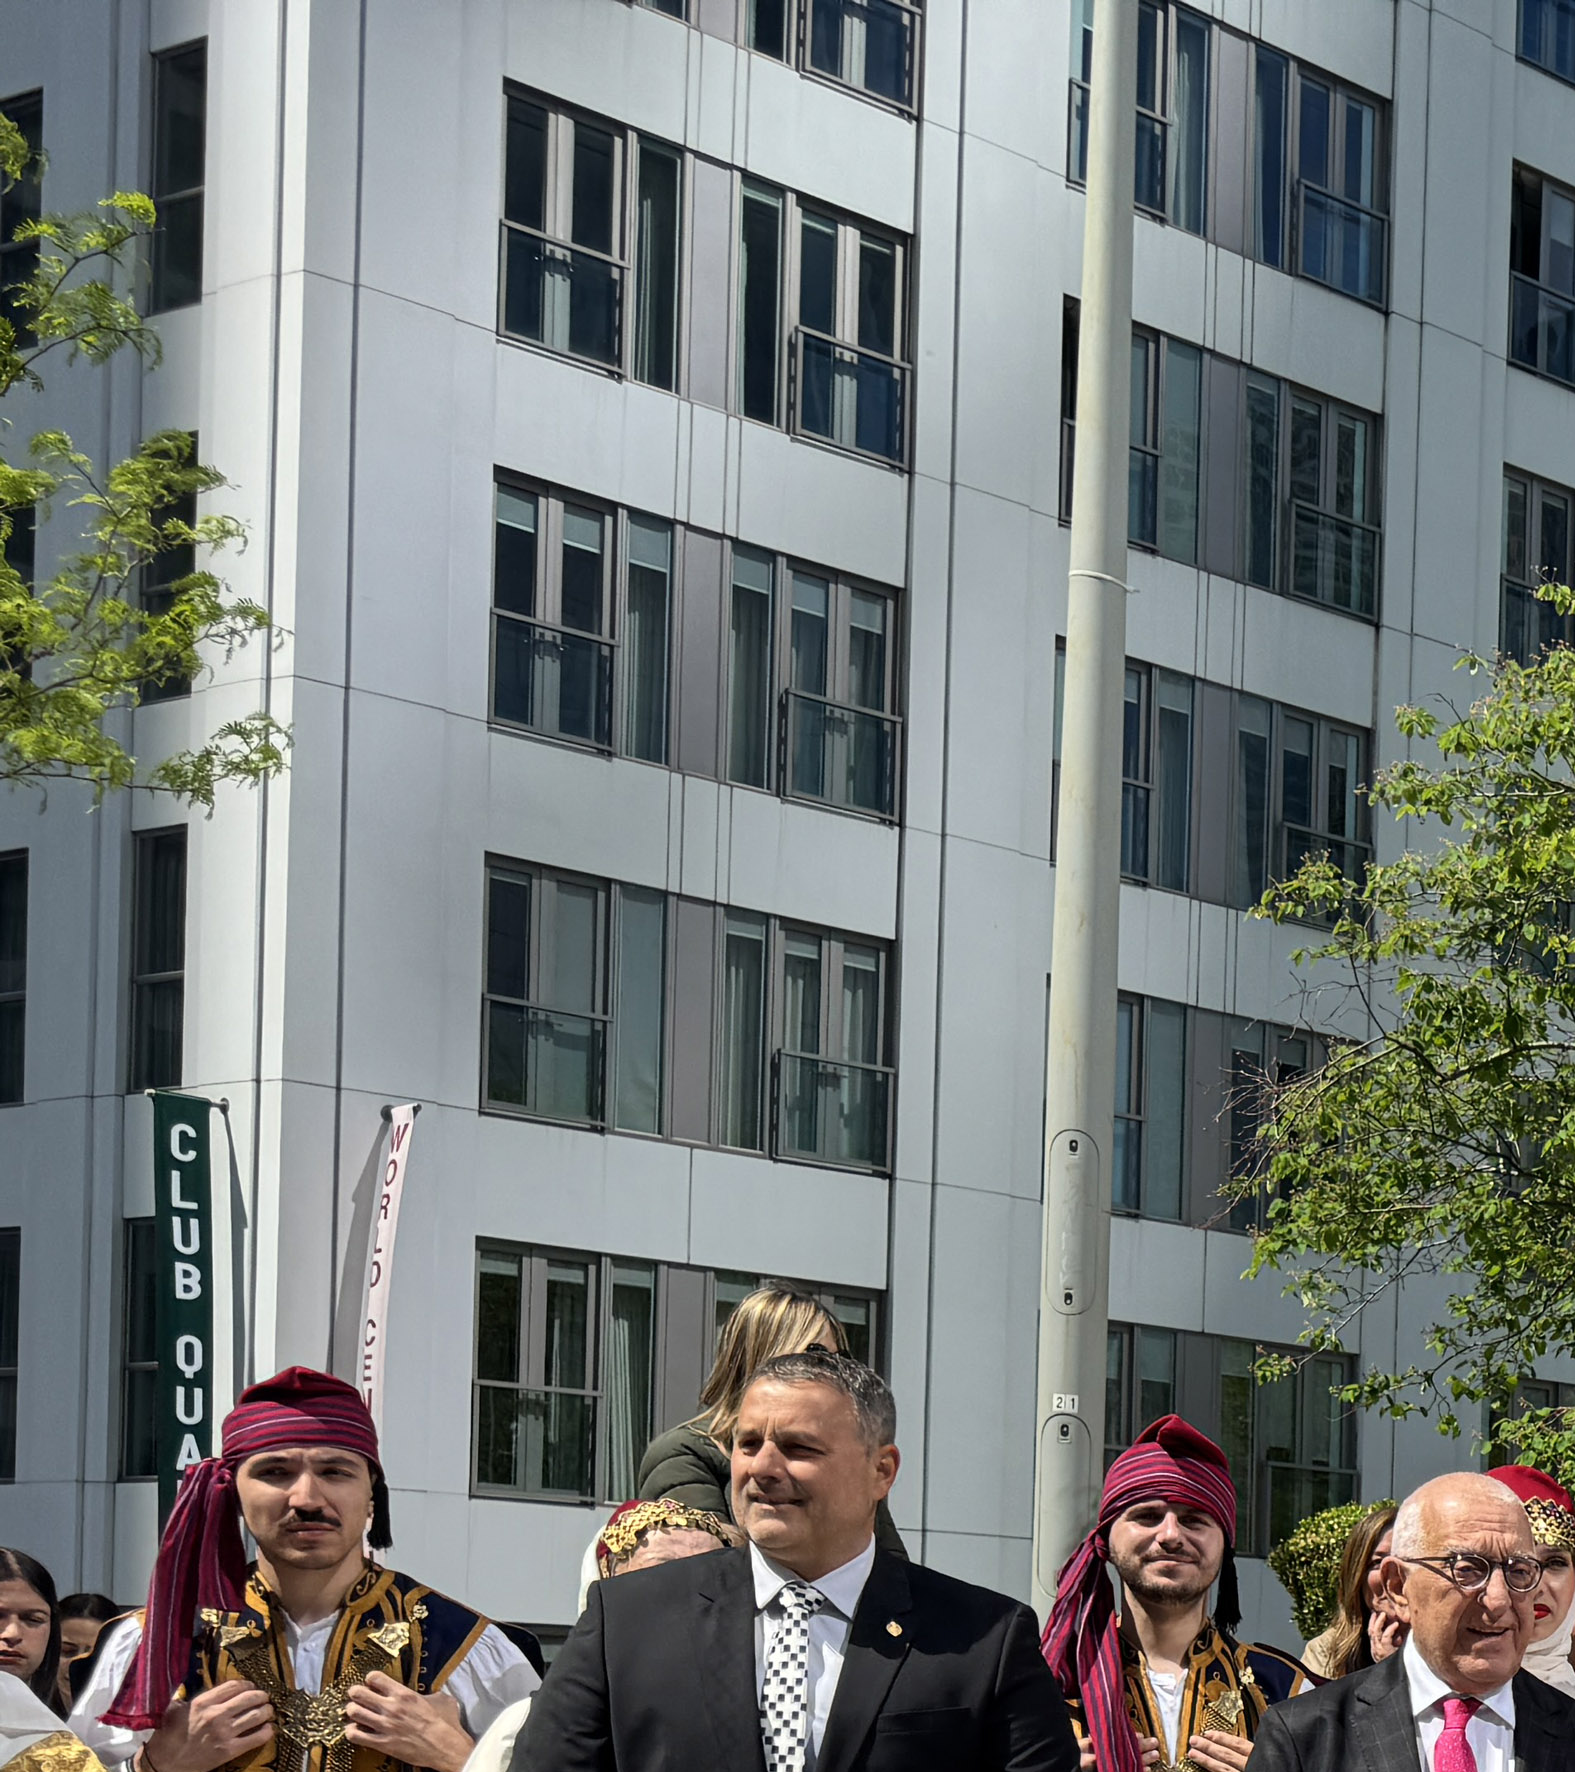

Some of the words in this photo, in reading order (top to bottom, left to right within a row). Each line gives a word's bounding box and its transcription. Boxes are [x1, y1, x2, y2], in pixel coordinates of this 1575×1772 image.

[170, 1122, 201, 1300] CLUB
[175, 1334, 203, 1494] QUA
[1056, 1396, 1075, 1410] 21
